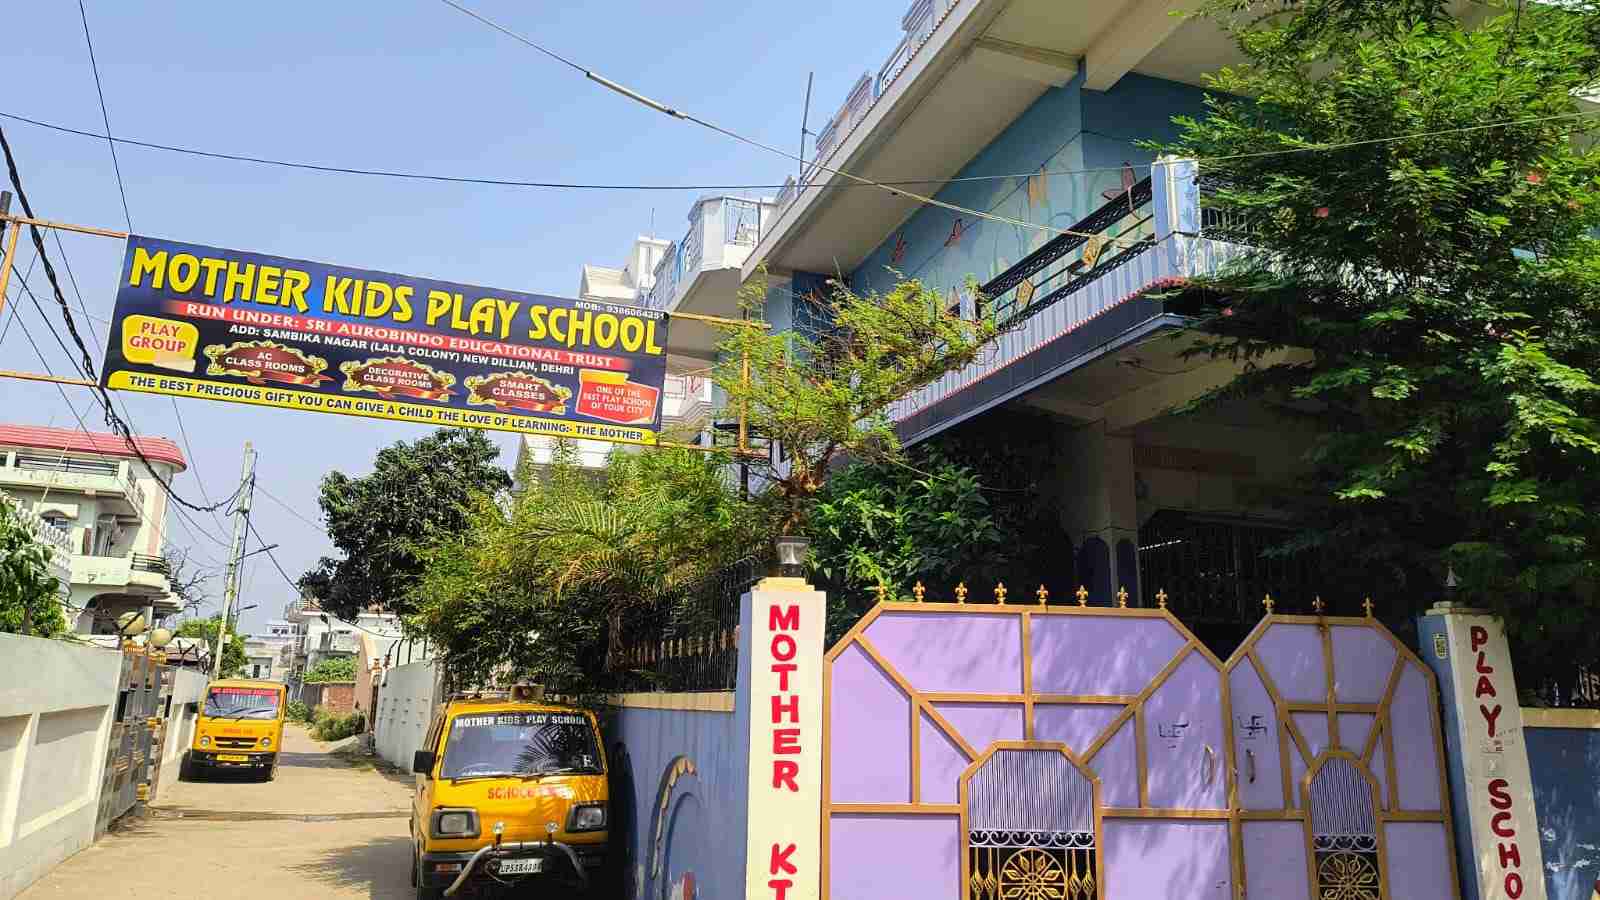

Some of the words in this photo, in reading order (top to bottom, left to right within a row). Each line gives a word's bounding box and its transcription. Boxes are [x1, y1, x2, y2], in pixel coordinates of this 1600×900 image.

[129, 247, 311, 313] MOTHER
[323, 275, 414, 323] KIDS
[426, 290, 520, 339] PLAY
[528, 305, 663, 356] SCHOOL
[142, 322, 181, 337] PLAY
[187, 304, 225, 318] RUN
[232, 309, 299, 328] UNDER:
[305, 319, 332, 332] SRI
[337, 324, 443, 346] AUROBINDO
[449, 338, 561, 361] EDUCATIONAL
[567, 352, 613, 367] TRUST
[129, 335, 187, 352] GROUP
[229, 324, 259, 336] ADD:
[263, 328, 320, 343] SAMBIKA
[324, 335, 367, 349] NAGAR
[370, 341, 405, 355] (LALA
[408, 347, 460, 363] COLONY)
[462, 353, 489, 365] NEW
[491, 358, 538, 372] DILLIAN,
[541, 363, 574, 375] DEHRI
[257, 352, 272, 361] AC
[225, 357, 261, 368] CLASS
[264, 362, 305, 373] ROOMS
[363, 374, 395, 384] CLASS
[398, 379, 433, 388] ROOMS
[368, 366, 430, 381] DECORATIVE
[499, 380, 541, 392] SMART
[492, 388, 546, 400] CLASSES
[130, 376, 155, 387] THE
[160, 380, 194, 393] BEST
[197, 384, 261, 399] PRECIOUS
[265, 391, 294, 403] GIFT
[298, 395, 323, 406] YOU
[326, 399, 352, 409] CAN
[355, 402, 384, 413] GIVE
[387, 406, 396, 415] A
[399, 406, 433, 418] CHILD
[437, 411, 460, 421] THE
[463, 413, 491, 425] LOVE
[494, 416, 509, 426] OF
[576, 425, 596, 435] THE
[600, 428, 643, 440] MOTHER
[623, 397, 652, 407] SCHOOL
[626, 405, 644, 414] CITY
[1470, 625, 1502, 738] PLAY
[768, 604, 801, 792] MOTHER
[455, 716, 496, 728] MOTHER
[496, 715, 521, 725] KIDS
[526, 715, 547, 724] PLAY
[551, 715, 586, 725] SCHOOL
